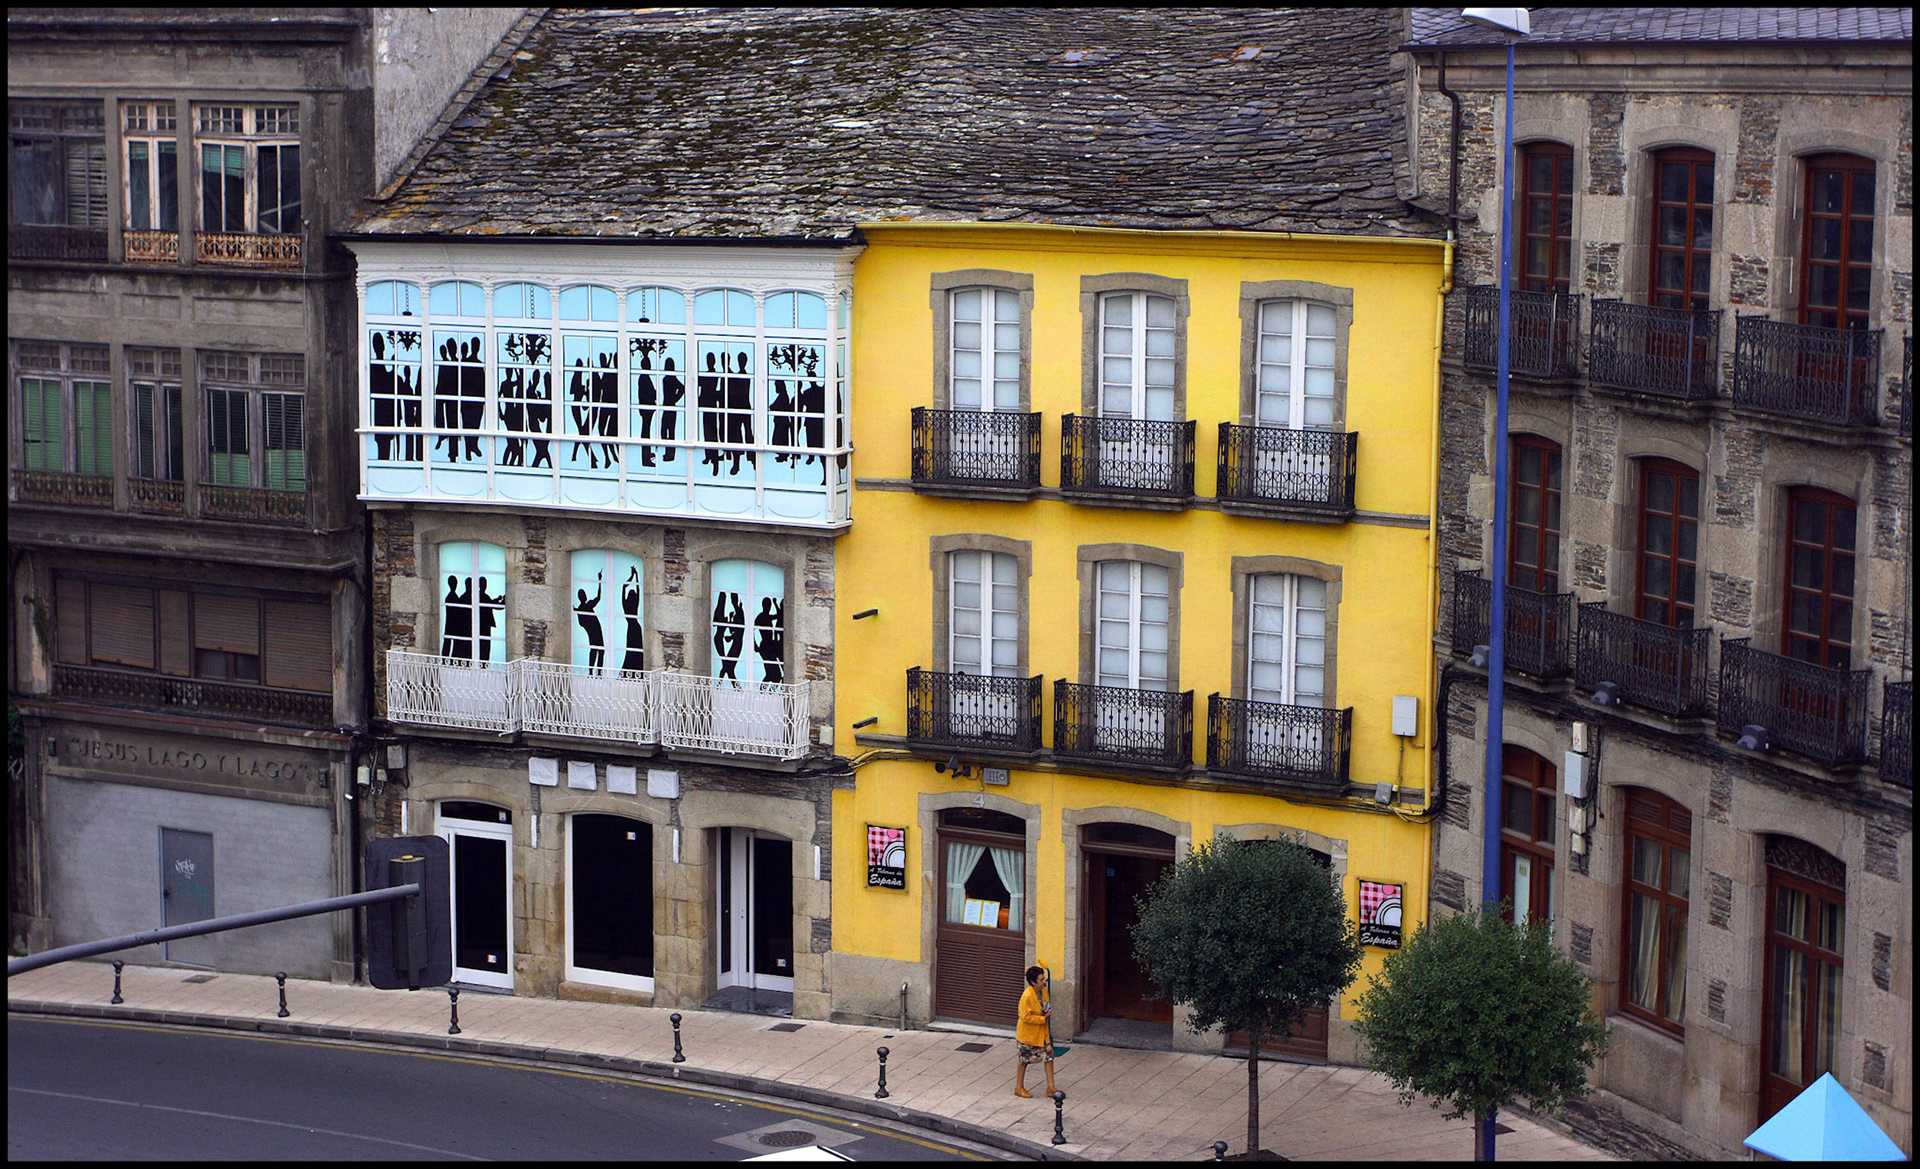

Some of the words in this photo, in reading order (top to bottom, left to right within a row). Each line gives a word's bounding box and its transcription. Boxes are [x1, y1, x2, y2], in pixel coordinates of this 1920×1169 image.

[148, 747, 207, 770] LAGO
[217, 755, 227, 772] Y
[972, 793, 985, 808] 4
[869, 873, 903, 886] España
[1360, 932, 1398, 946] España
